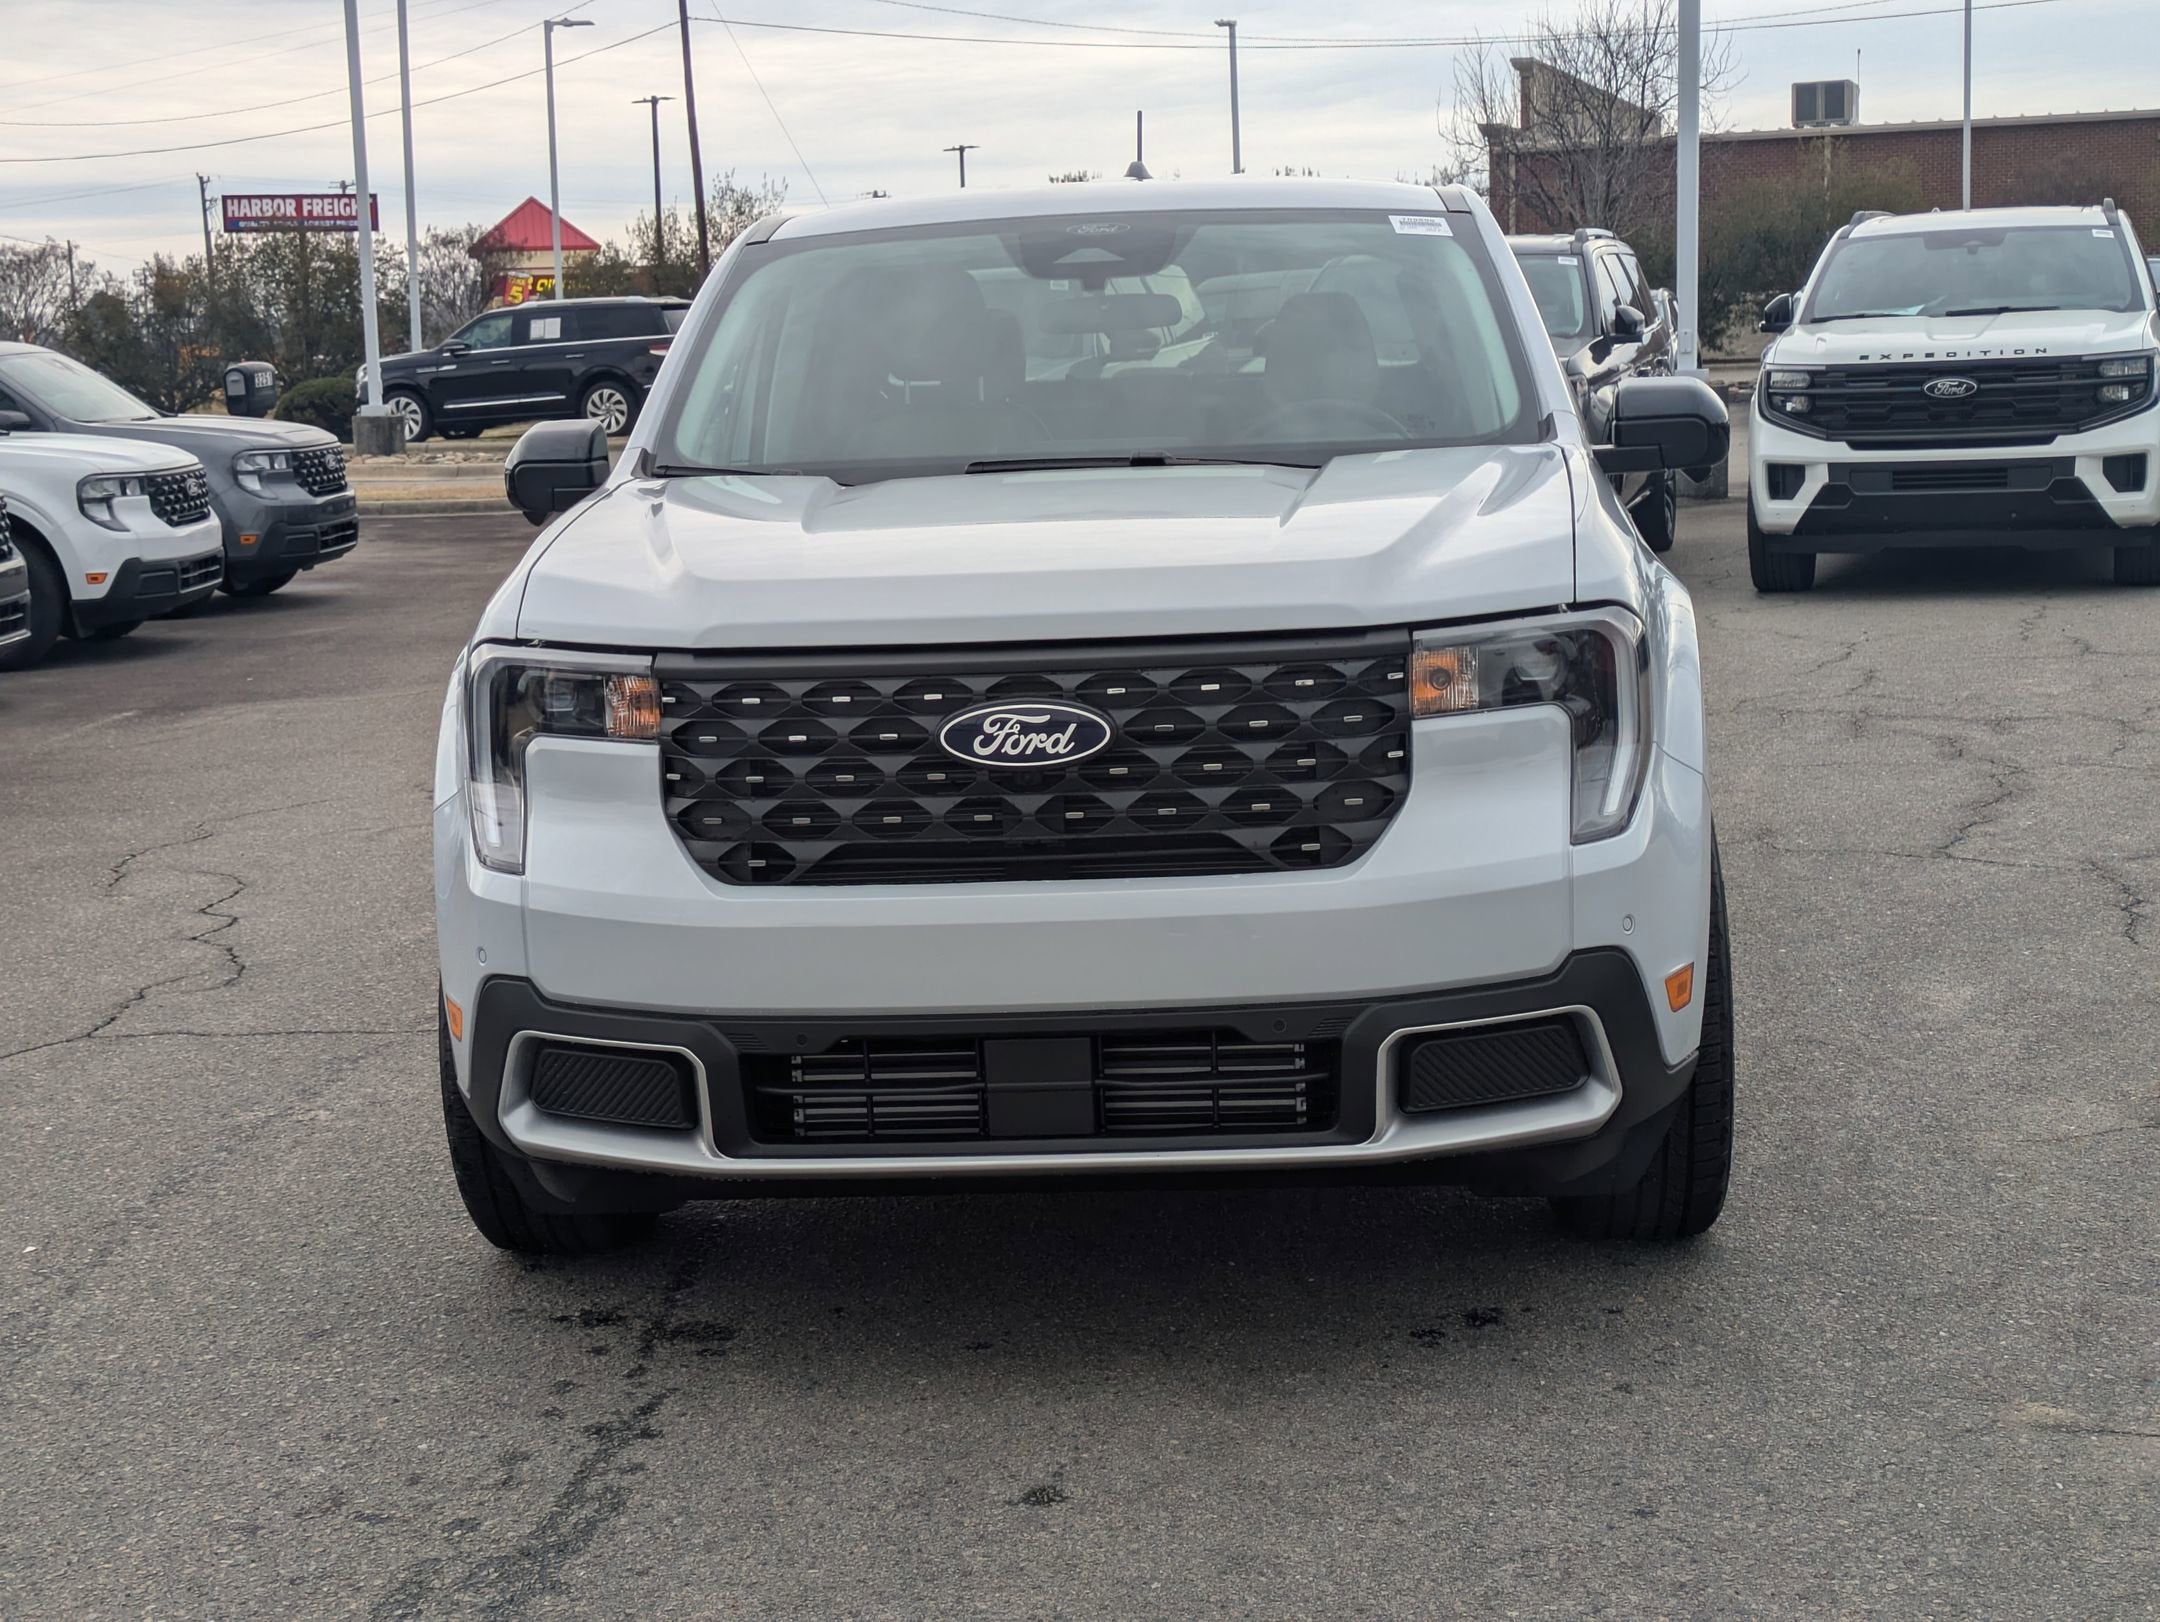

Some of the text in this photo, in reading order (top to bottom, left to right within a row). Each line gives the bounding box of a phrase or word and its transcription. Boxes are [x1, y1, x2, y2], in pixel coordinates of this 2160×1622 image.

[227, 198, 373, 217] HARBOR FREIG
[508, 285, 523, 304] 5
[1859, 348, 2047, 360] EXPEDITION
[1934, 381, 1966, 396] Ford
[973, 714, 1077, 756] Ford
